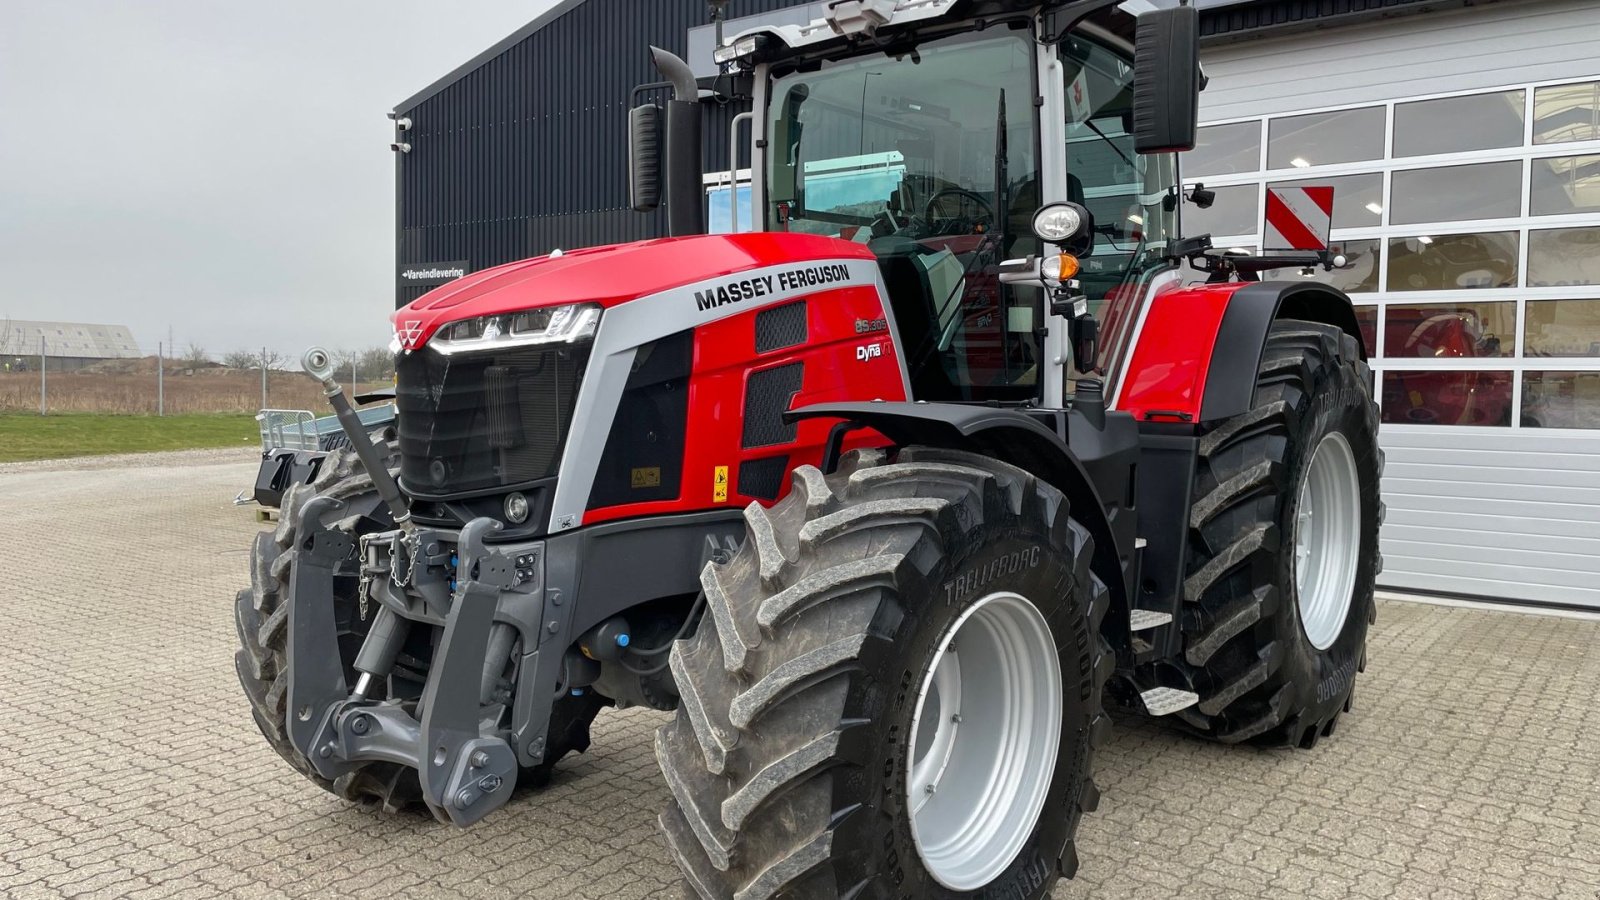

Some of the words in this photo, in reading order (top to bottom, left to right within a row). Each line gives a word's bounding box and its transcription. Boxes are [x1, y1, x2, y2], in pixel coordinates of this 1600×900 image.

[407, 267, 464, 280] Vareindlevering
[694, 275, 773, 312] MASSEY
[777, 264, 850, 291] FERGUSON
[944, 545, 1040, 607] TRELLEBORG
